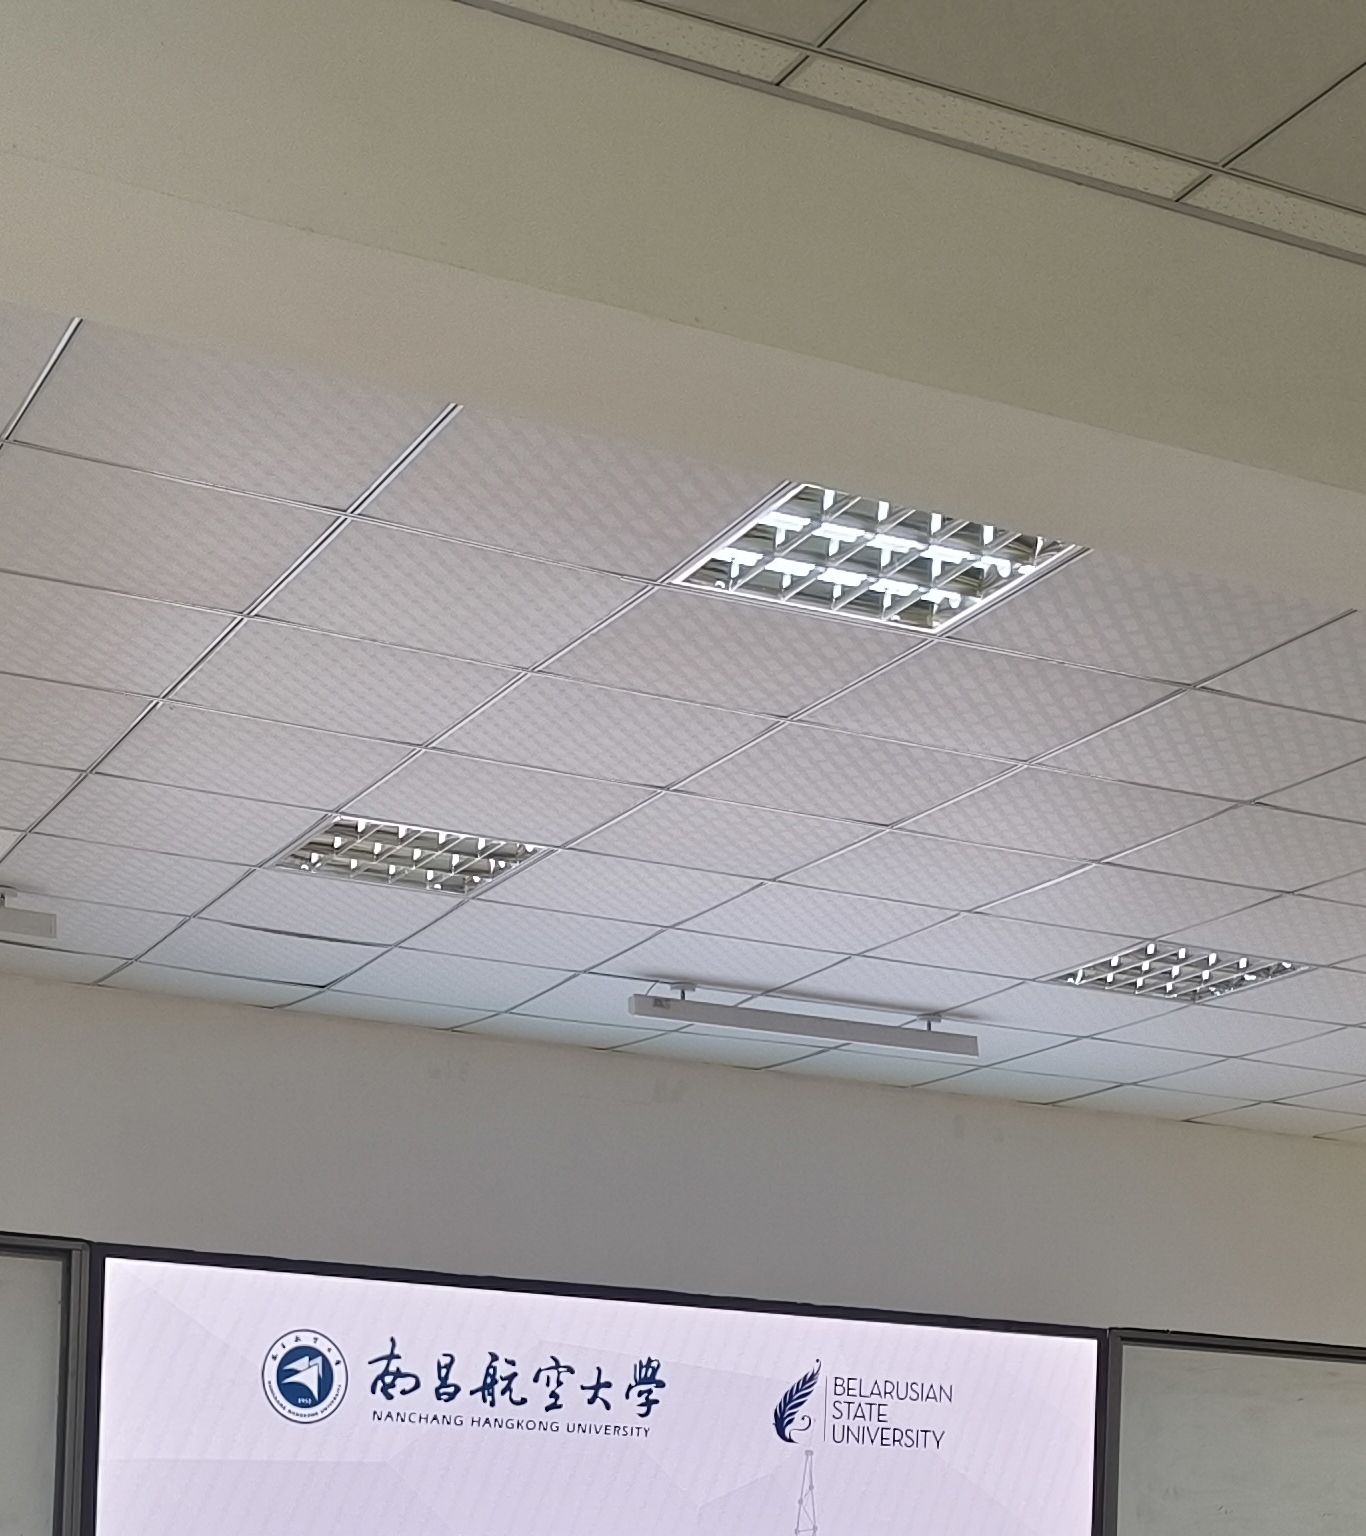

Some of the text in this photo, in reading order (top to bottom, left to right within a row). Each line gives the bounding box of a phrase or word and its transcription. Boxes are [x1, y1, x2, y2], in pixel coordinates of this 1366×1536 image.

[834, 1376, 953, 1403] BELARUSIAN
[371, 1409, 651, 1439] NANCHANG HANGKONG UNIVERSITY
[832, 1400, 889, 1423] STATE
[832, 1424, 945, 1449] UNIVERSITY
